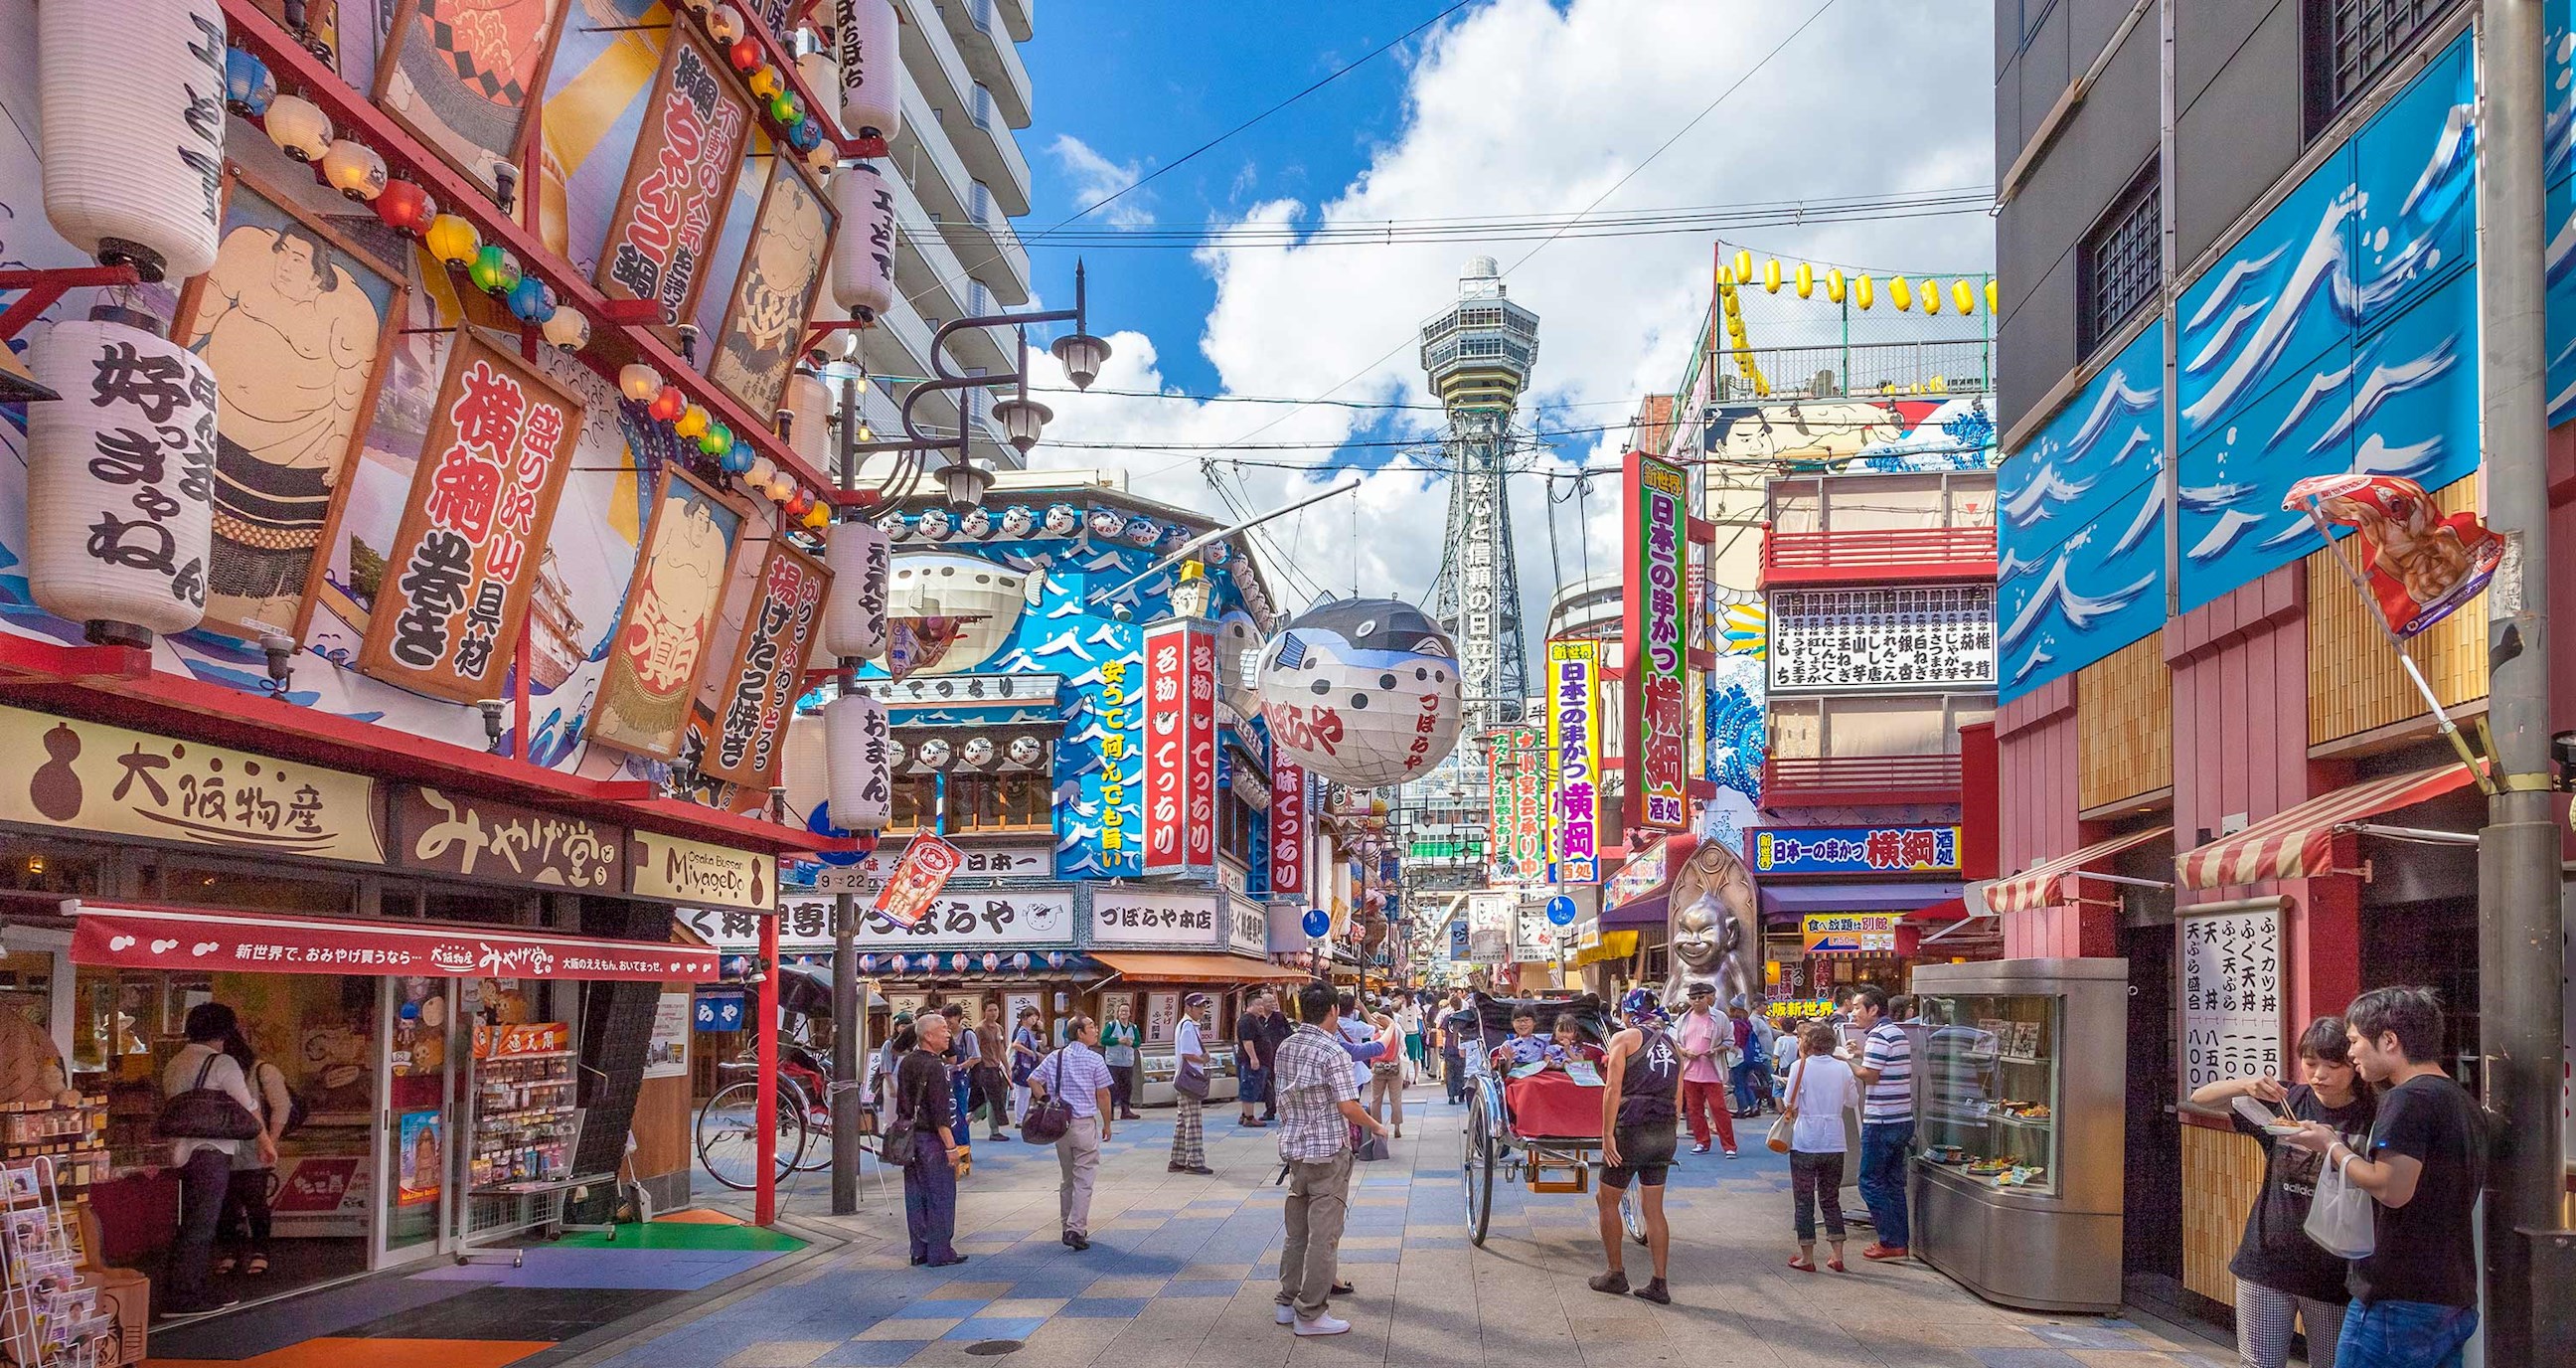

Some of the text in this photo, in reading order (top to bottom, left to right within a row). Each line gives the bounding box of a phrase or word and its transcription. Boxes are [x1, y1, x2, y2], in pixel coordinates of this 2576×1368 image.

[394, 360, 527, 669] 横綱巻き
[453, 403, 564, 681] 盛り沢山具材
[721, 555, 802, 769] 揚げたこ焼き
[1552, 645, 1593, 660] 新世界
[1643, 462, 1684, 823] 新世界 日本一の串かつ 横綱 酒処
[1776, 639, 1791, 684] もち
[1792, 639, 1807, 684] うずら玉子
[1807, 638, 1821, 683] 紅しょうが
[1823, 638, 1837, 683] にんにく
[1838, 637, 1852, 682] 玉ねぎ
[1852, 637, 1866, 682] 山芋
[1868, 636, 1882, 681] しし唐
[1883, 636, 1897, 681] れんこん
[1898, 635, 1913, 680] 銀杏
[1914, 635, 1928, 680] 白ねぎ
[1929, 634, 1944, 679] さつま芋
[1945, 634, 1959, 679] じゃが芋
[1960, 633, 1975, 678] 茄子
[1404, 692, 1439, 770] づぼらや
[1559, 662, 1587, 779] 日本一の串かつ
[1100, 660, 1126, 867] 安うて何んでも旨い
[1154, 646, 1178, 854] 名物 てっちり
[1190, 645, 1213, 854] 名物 てっちり
[112, 743, 323, 833] 大阪物産
[416, 787, 598, 888] みやげ堂
[1552, 782, 1594, 858] 横綱
[667, 847, 744, 892] MiyageDo
[689, 851, 714, 866] Osaka
[967, 853, 1038, 871] 日本一
[1759, 831, 1954, 868] 新世界 日本一の串かつ 横綱 酒処
[848, 875, 865, 888] 22
[1100, 909, 1211, 930] づぼらや本店
[430, 946, 474, 965] 大阪物産
[2186, 923, 2201, 1010] 天ぷら盛合
[2203, 922, 2218, 1010] 天丼
[2222, 921, 2237, 1011] ふぐ天ぷら
[2240, 919, 2256, 1012] ふぐ天丼
[2260, 917, 2277, 1012] ふぐカツ丼
[509, 1031, 555, 1052] 通天閣
[1647, 1043, 1677, 1078] 俥
